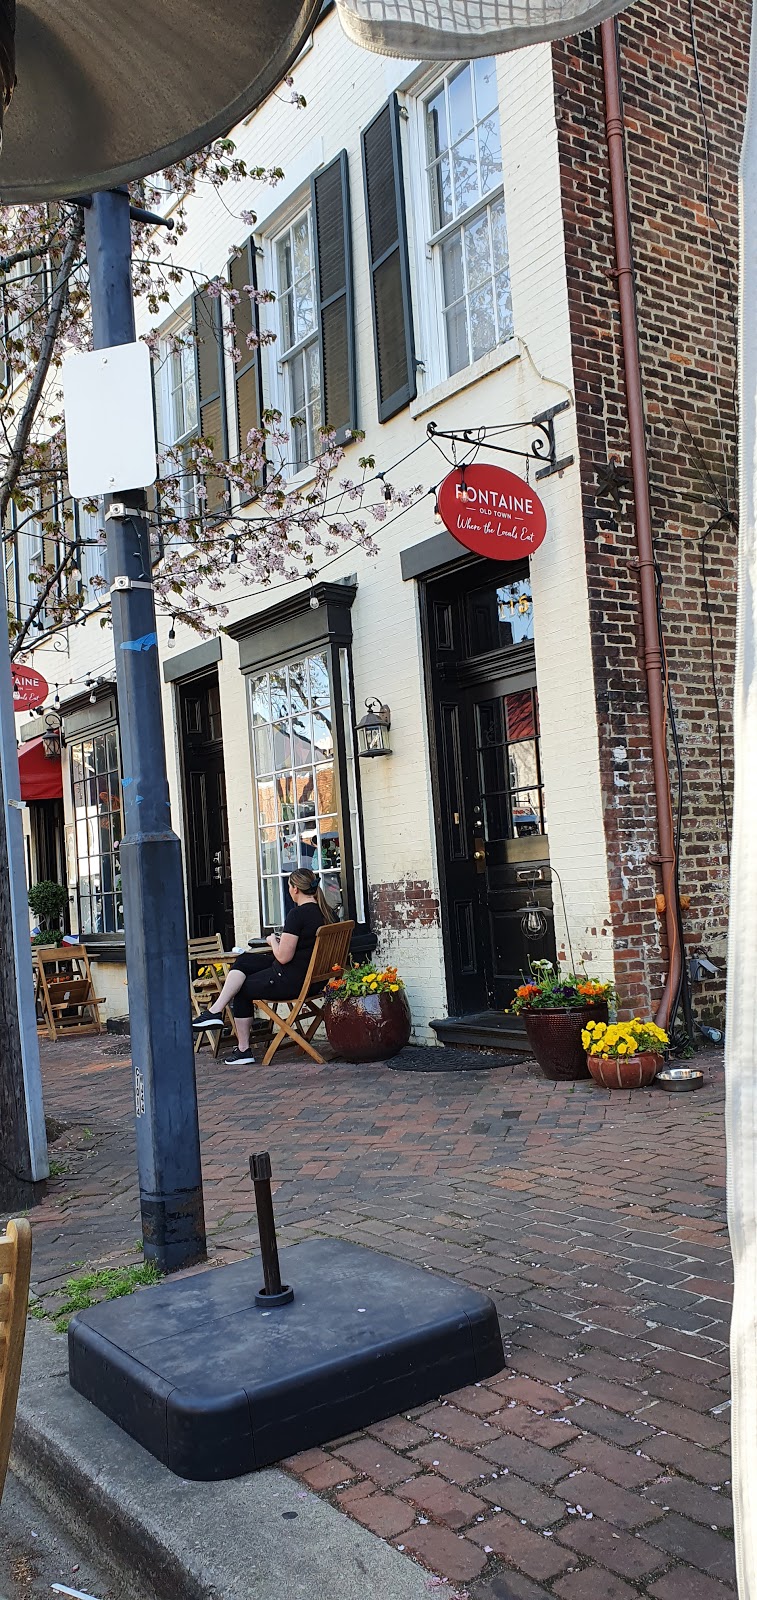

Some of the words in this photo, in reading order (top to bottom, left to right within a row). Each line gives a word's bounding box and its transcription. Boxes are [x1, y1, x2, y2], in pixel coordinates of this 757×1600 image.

[455, 484, 534, 515] FONTAINE
[479, 508, 492, 516] OLD
[493, 510, 512, 520] TOWN
[456, 514, 482, 531] Where
[483, 521, 495, 534] the
[496, 522, 518, 540] Locals
[520, 526, 535, 543] Eat
[12, 676, 40, 687] AINE
